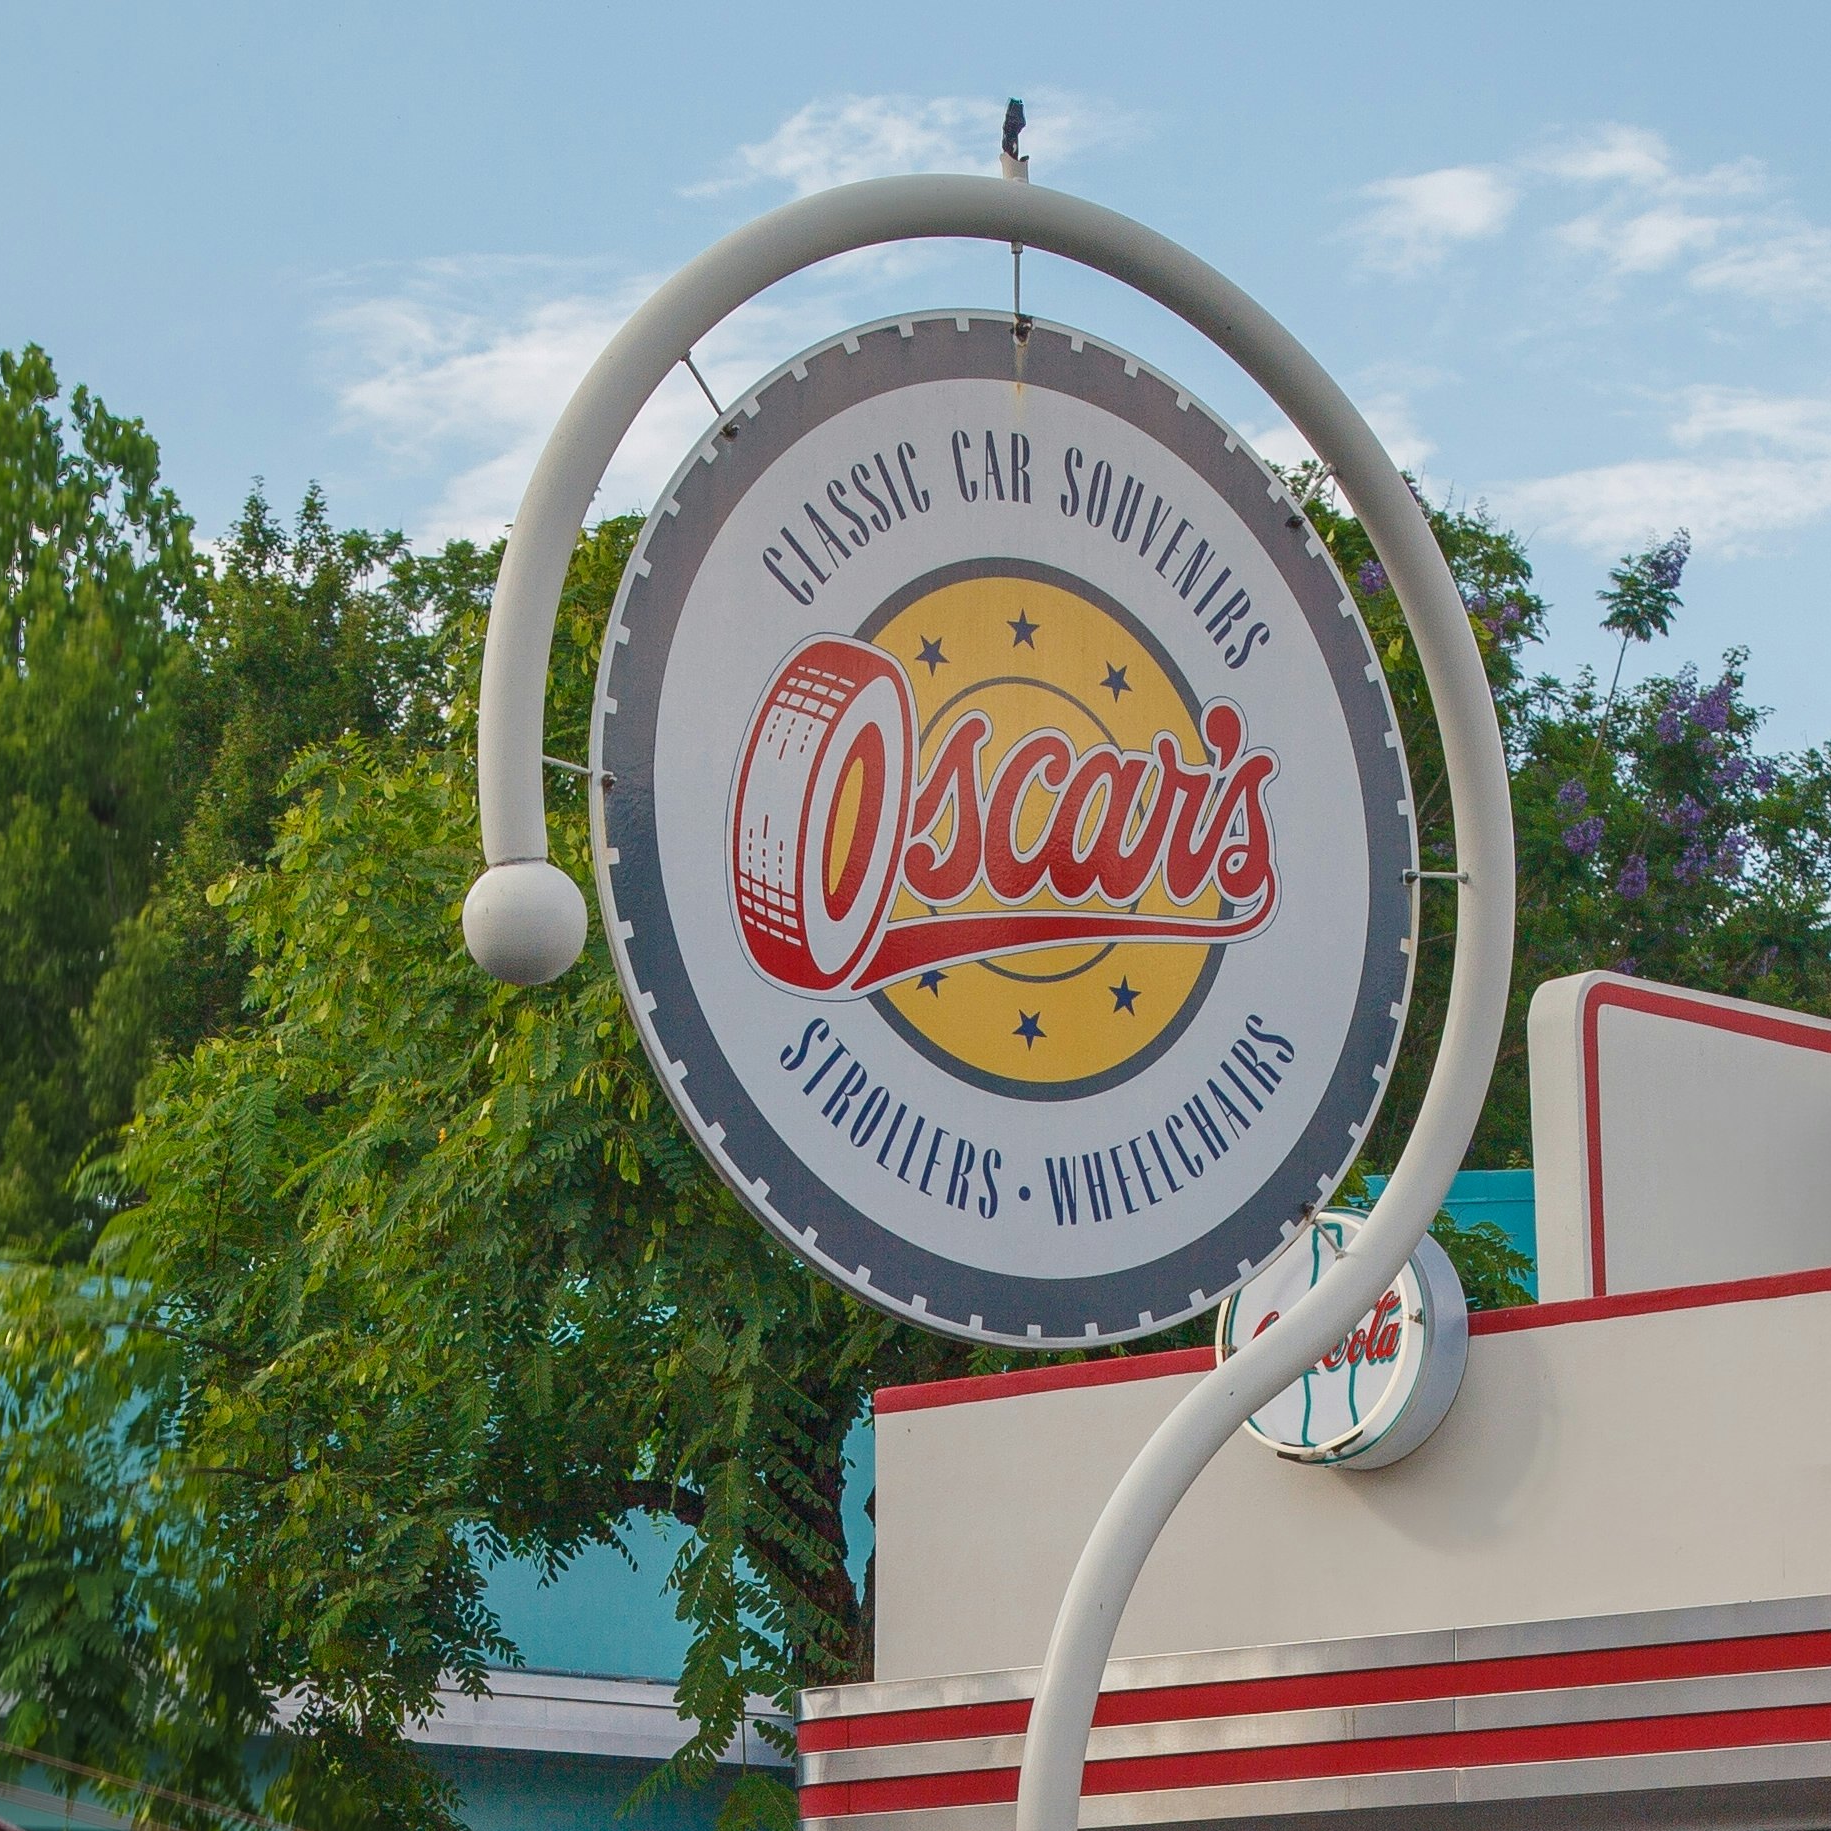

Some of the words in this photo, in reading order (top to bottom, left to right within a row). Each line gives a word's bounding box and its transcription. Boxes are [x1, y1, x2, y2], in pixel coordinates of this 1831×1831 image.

[762, 441, 931, 606] CLASSIC
[950, 430, 1031, 506] CAR
[1059, 447, 1270, 670] SOUVENIRS
[731, 636, 1280, 993] Oscar's
[779, 1017, 1001, 1219] STROLLERS
[1045, 1012, 1296, 1226] WHEELCHAIRS
